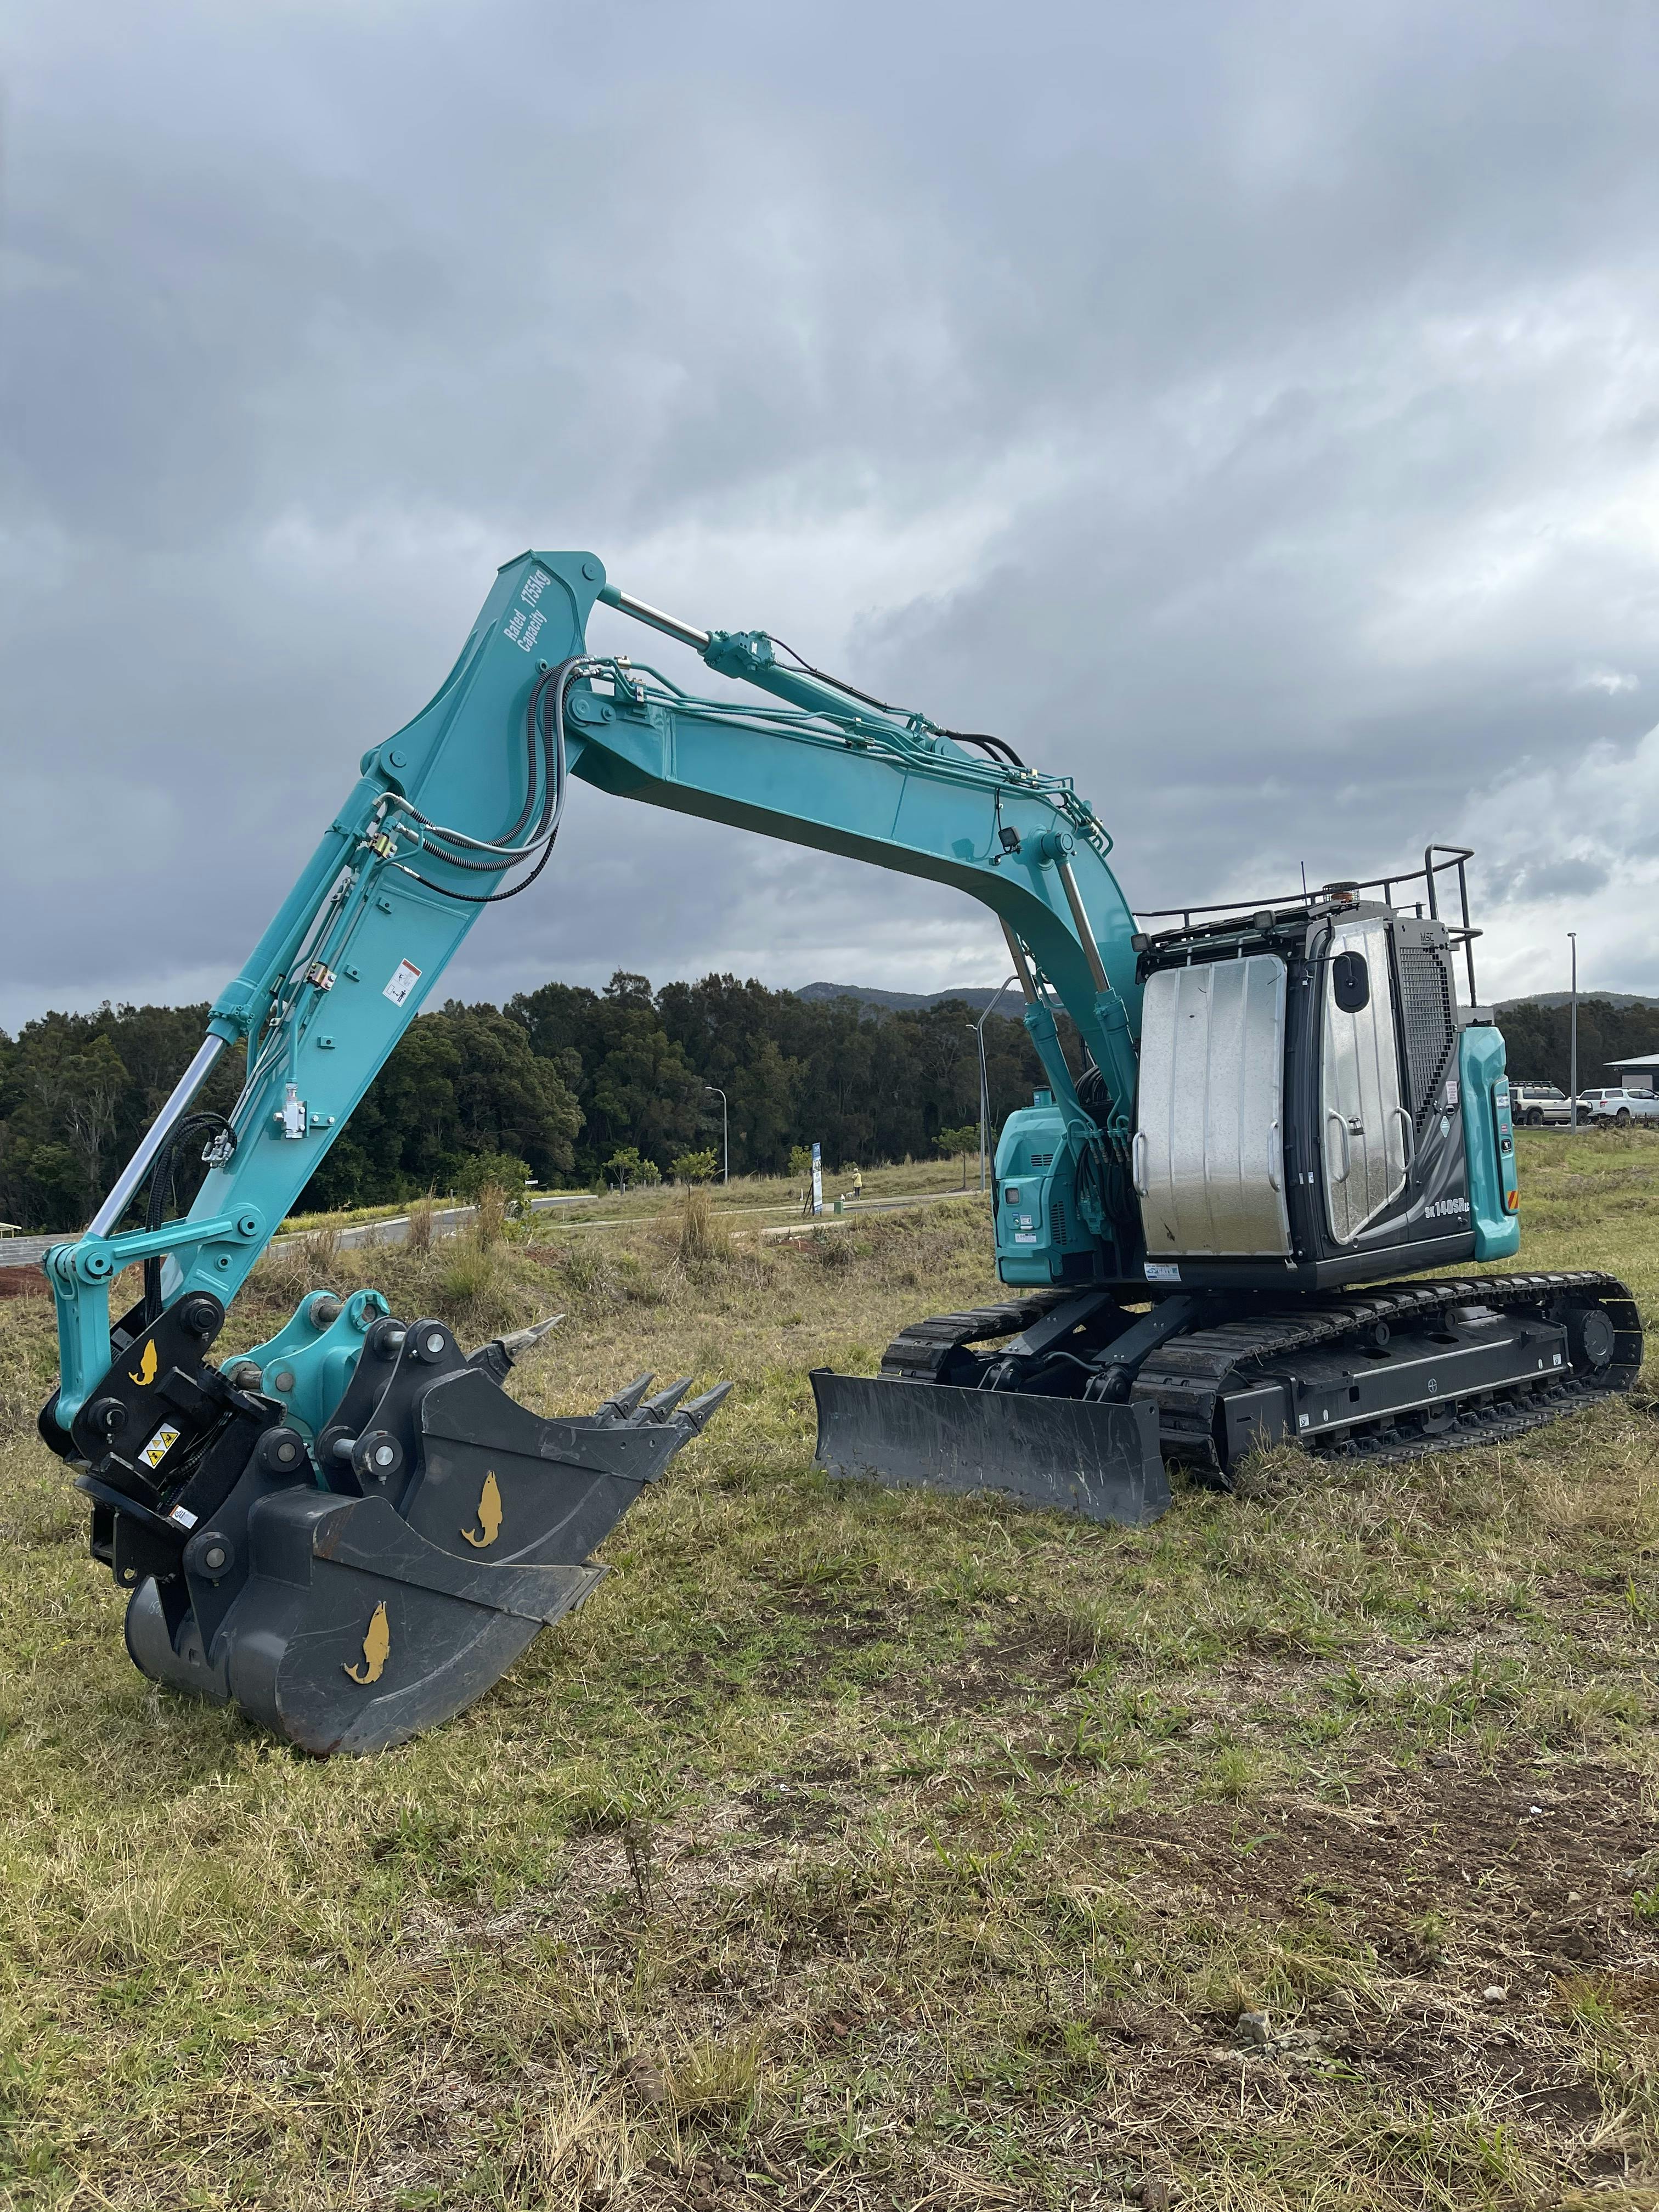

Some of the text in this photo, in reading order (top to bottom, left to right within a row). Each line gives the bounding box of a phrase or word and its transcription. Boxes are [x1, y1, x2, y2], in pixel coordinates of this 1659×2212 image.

[503, 569, 551, 642] Rated 1755kg
[517, 610, 548, 653] Capacity
